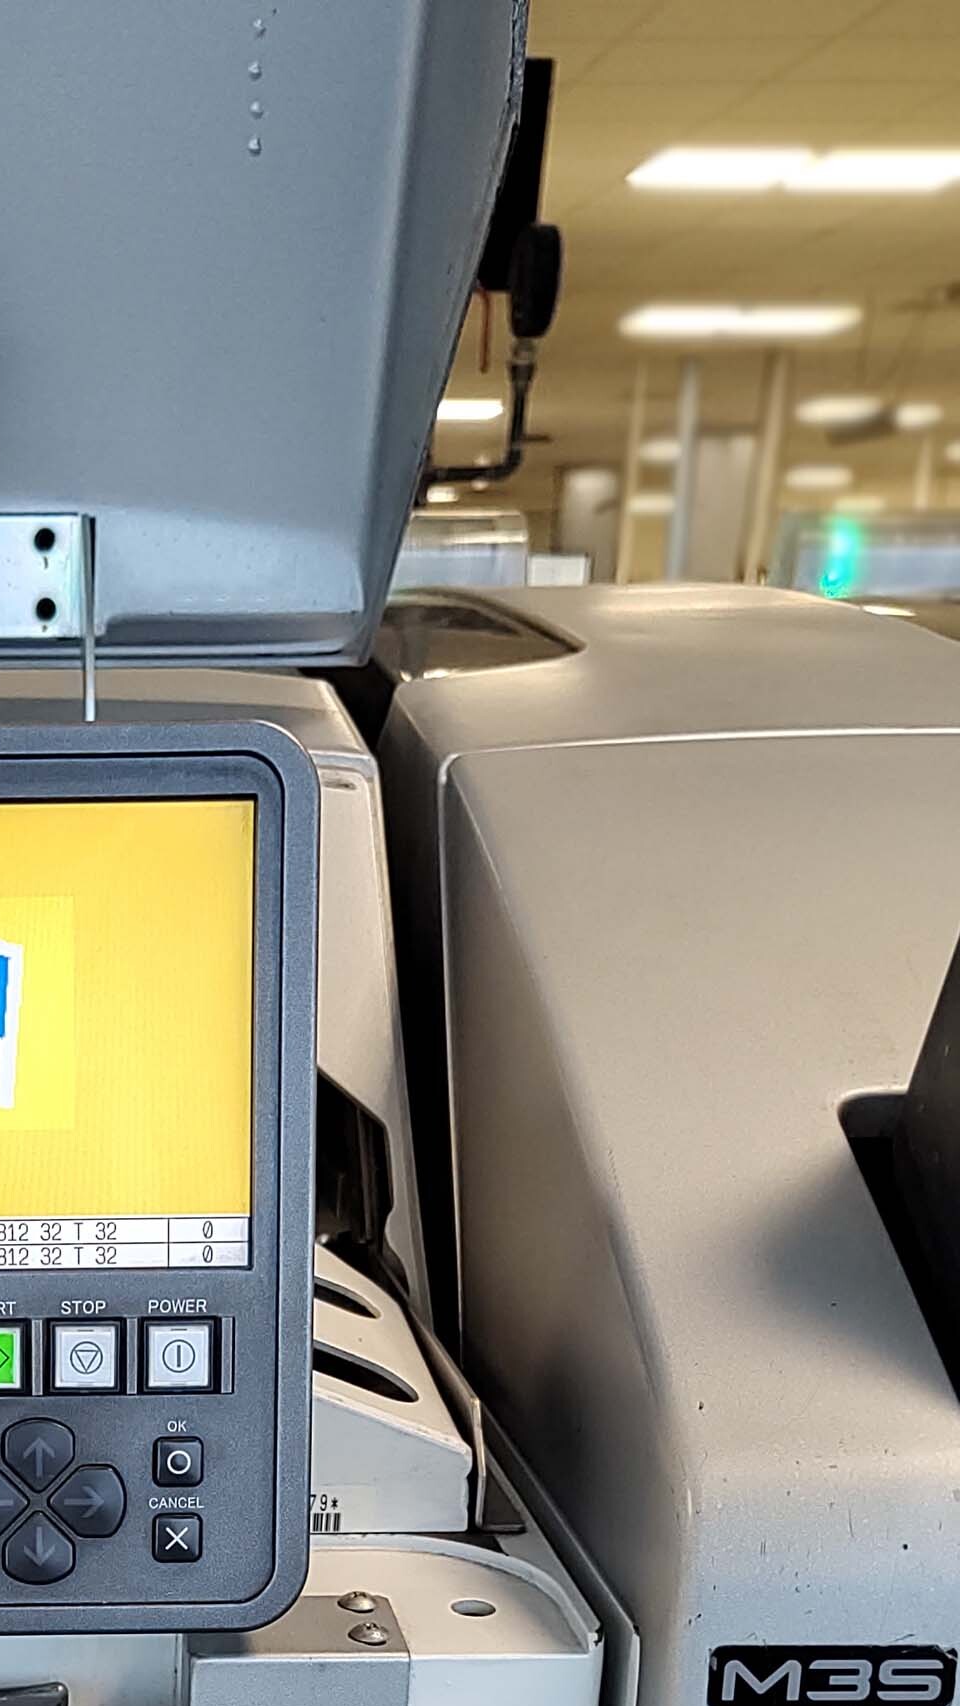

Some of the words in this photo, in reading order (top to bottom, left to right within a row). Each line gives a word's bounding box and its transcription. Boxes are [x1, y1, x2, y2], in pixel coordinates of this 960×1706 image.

[40, 1222, 63, 1242] 32
[73, 1222, 84, 1241] T
[95, 1221, 118, 1241] 32
[202, 1220, 214, 1240] 0
[40, 1247, 63, 1266] 32
[73, 1247, 84, 1265] T
[95, 1246, 118, 1265] 32
[202, 1245, 214, 1264] 0
[60, 1300, 107, 1315] STOP
[148, 1299, 208, 1314] POWER
[167, 1420, 188, 1433] OK
[148, 1496, 205, 1510] CANCEL
[721, 1659, 944, 1702] M3S
